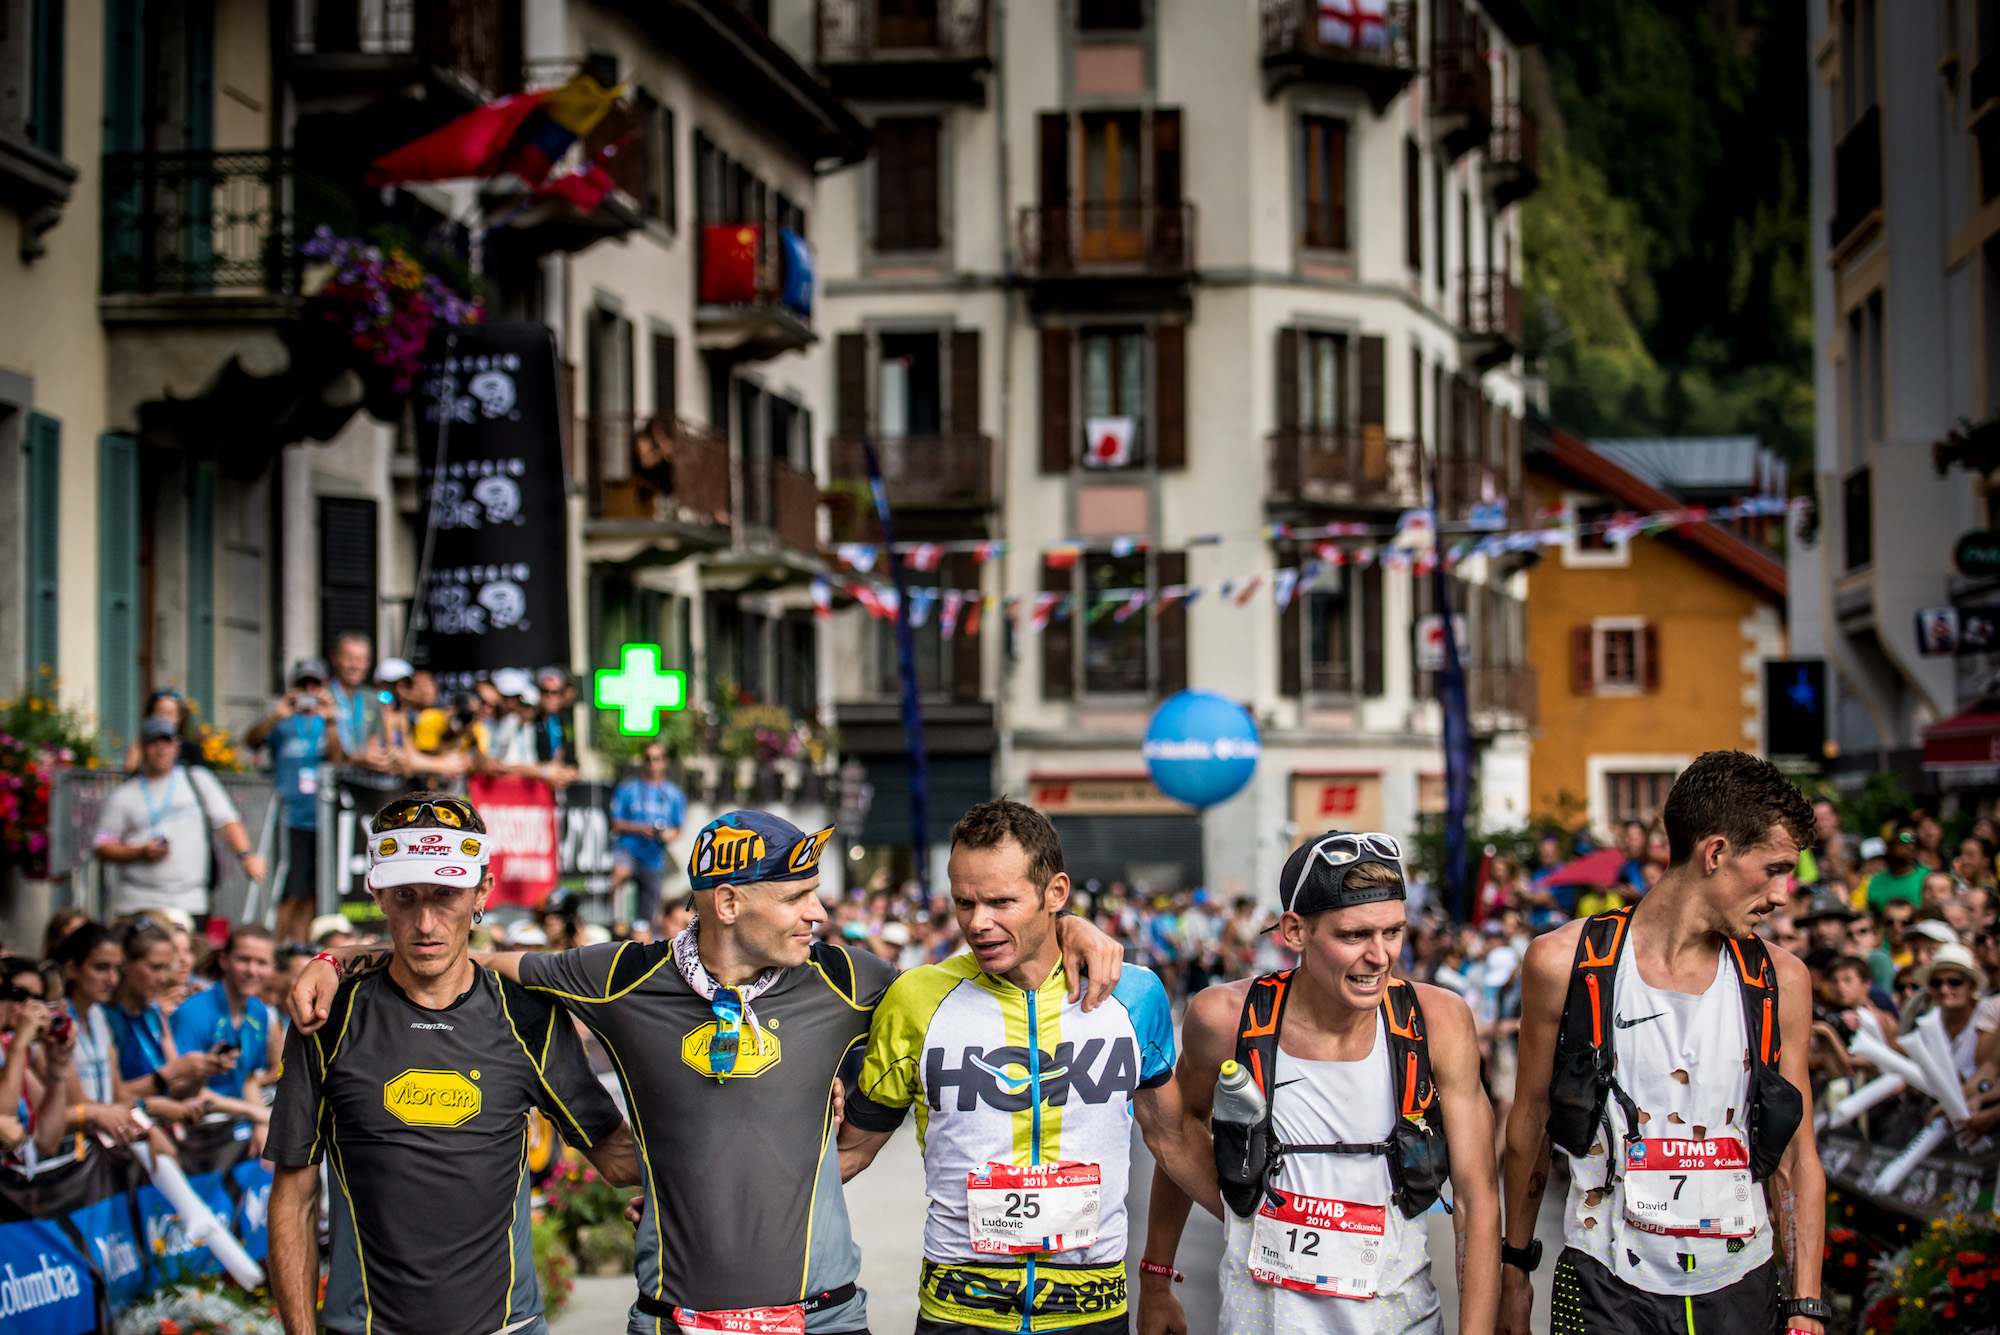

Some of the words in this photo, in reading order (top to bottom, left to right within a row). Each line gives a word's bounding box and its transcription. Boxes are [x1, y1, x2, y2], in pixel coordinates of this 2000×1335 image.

[421, 844, 452, 853] SPORT
[687, 1034, 776, 1057] viam
[926, 1036, 1134, 1112] HOKA
[389, 1082, 475, 1109] vibram
[1662, 1141, 1716, 1157] UTMB
[1679, 1159, 1705, 1168] 2016
[1023, 1178, 1048, 1187] 2016
[1064, 1174, 1099, 1184] Columbia
[1669, 1175, 1687, 1200] 7
[1004, 1193, 1041, 1219] 25
[1293, 1196, 1345, 1218] UTMB
[1637, 1201, 1667, 1211] David
[982, 1218, 1023, 1229] Ludovic
[1306, 1215, 1331, 1228] 2016
[1347, 1221, 1382, 1233] Columbia
[1286, 1228, 1320, 1257] 12
[1261, 1245, 1279, 1259] Tim
[725, 1320, 751, 1331] 2016
